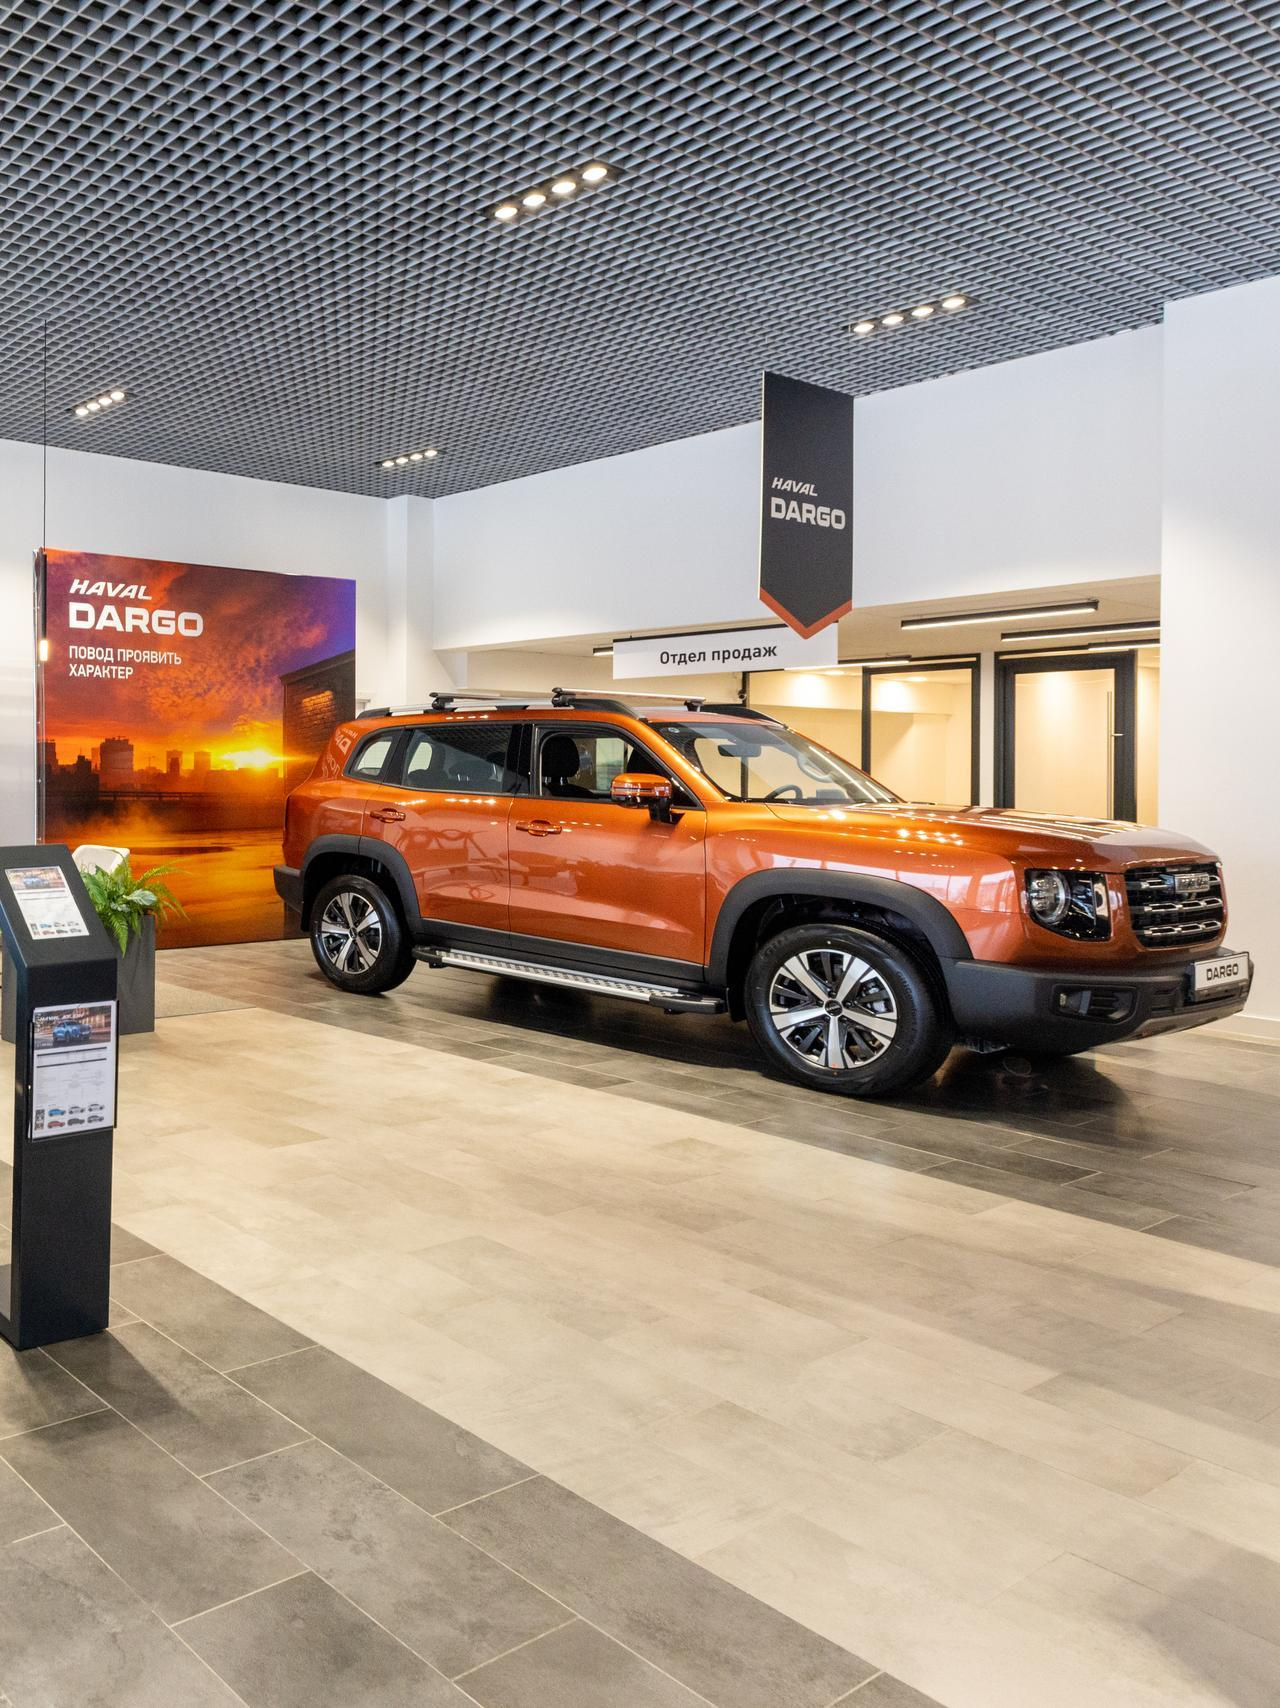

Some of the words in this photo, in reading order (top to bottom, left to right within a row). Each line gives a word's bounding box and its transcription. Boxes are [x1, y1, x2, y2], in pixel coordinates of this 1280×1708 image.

[771, 477, 818, 497] HAVAL
[770, 497, 846, 530] DARGO
[69, 579, 153, 600] HAVAL
[69, 602, 204, 637] DARGO
[69, 645, 114, 663] ПОВОД
[117, 648, 182, 665] ПРОЯВИТЬ
[660, 651, 706, 665] Отдел
[711, 645, 777, 663] продаж
[69, 663, 134, 679] ХАРАКТЕР
[1206, 963, 1239, 981] DARGO
